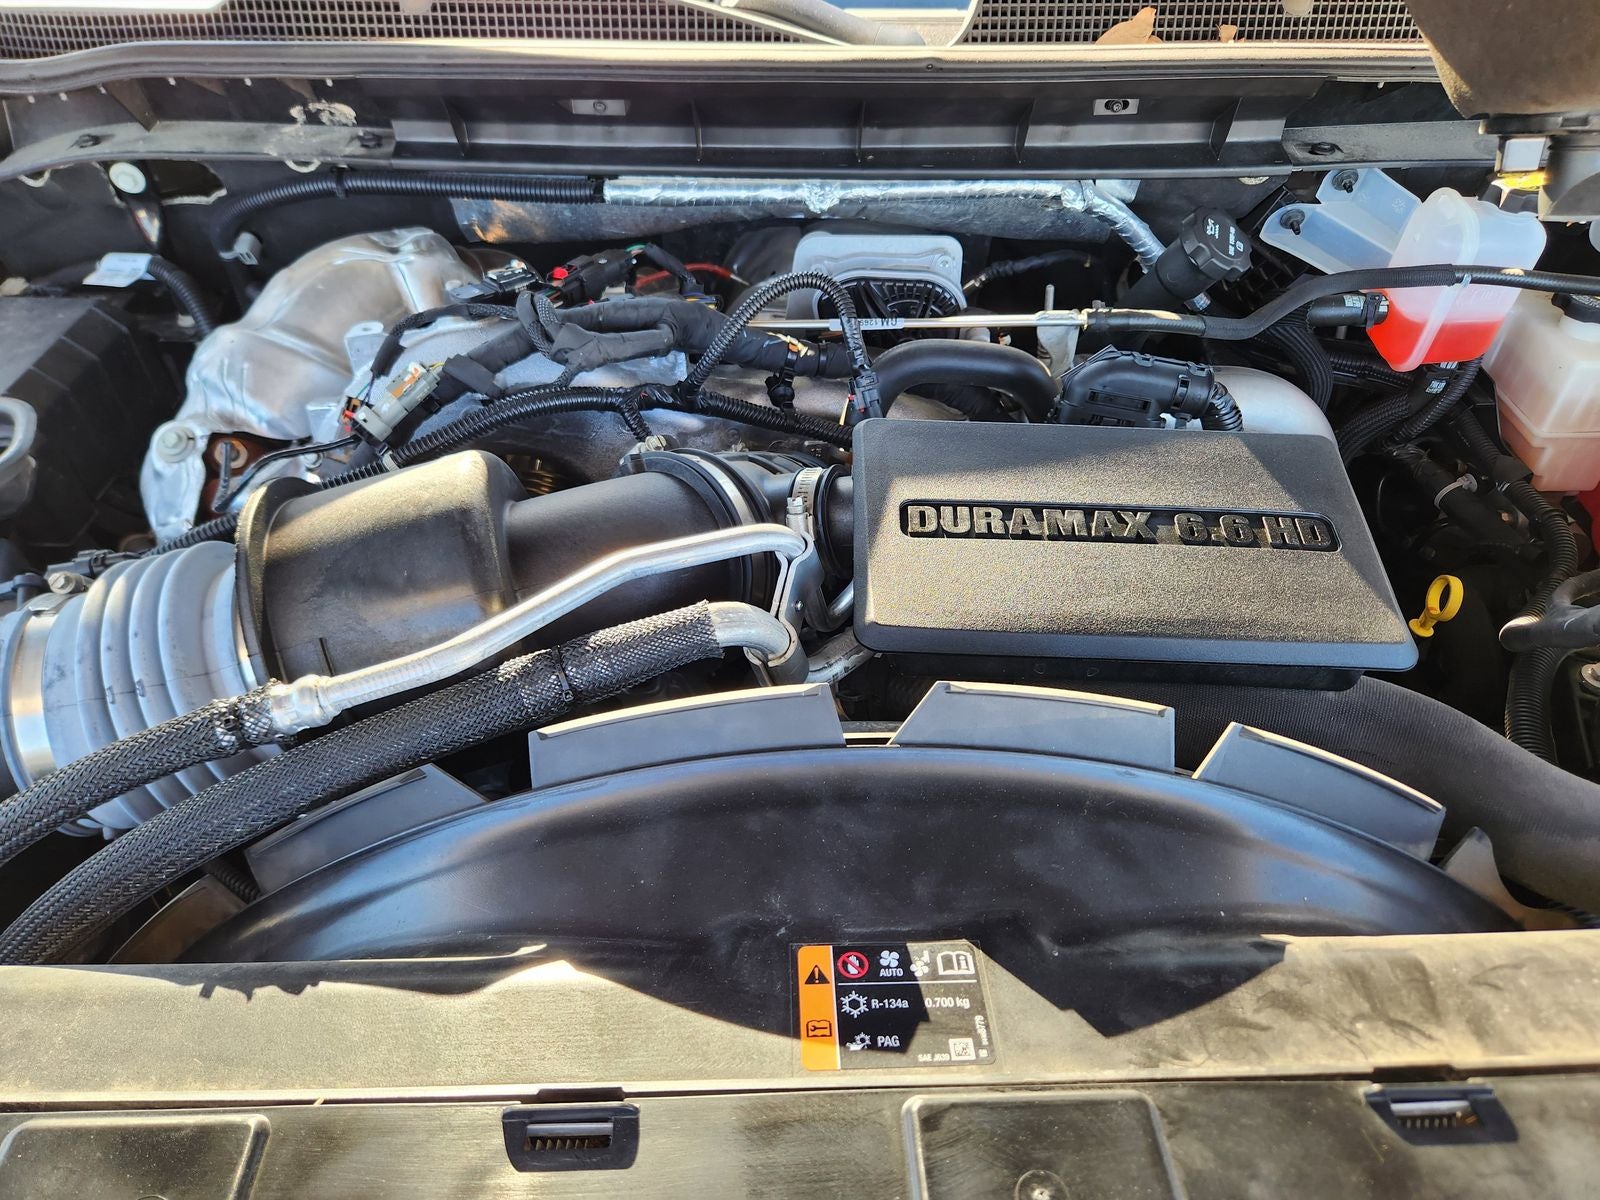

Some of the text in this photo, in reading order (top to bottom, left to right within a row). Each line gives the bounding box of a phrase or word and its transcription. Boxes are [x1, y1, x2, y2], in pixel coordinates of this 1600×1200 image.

[907, 505, 1329, 548] DURAMAX 6.6 HD
[879, 968, 904, 977] AUTO
[871, 996, 970, 1009] R-134a 0.700 kg
[877, 1034, 900, 1047] PAG
